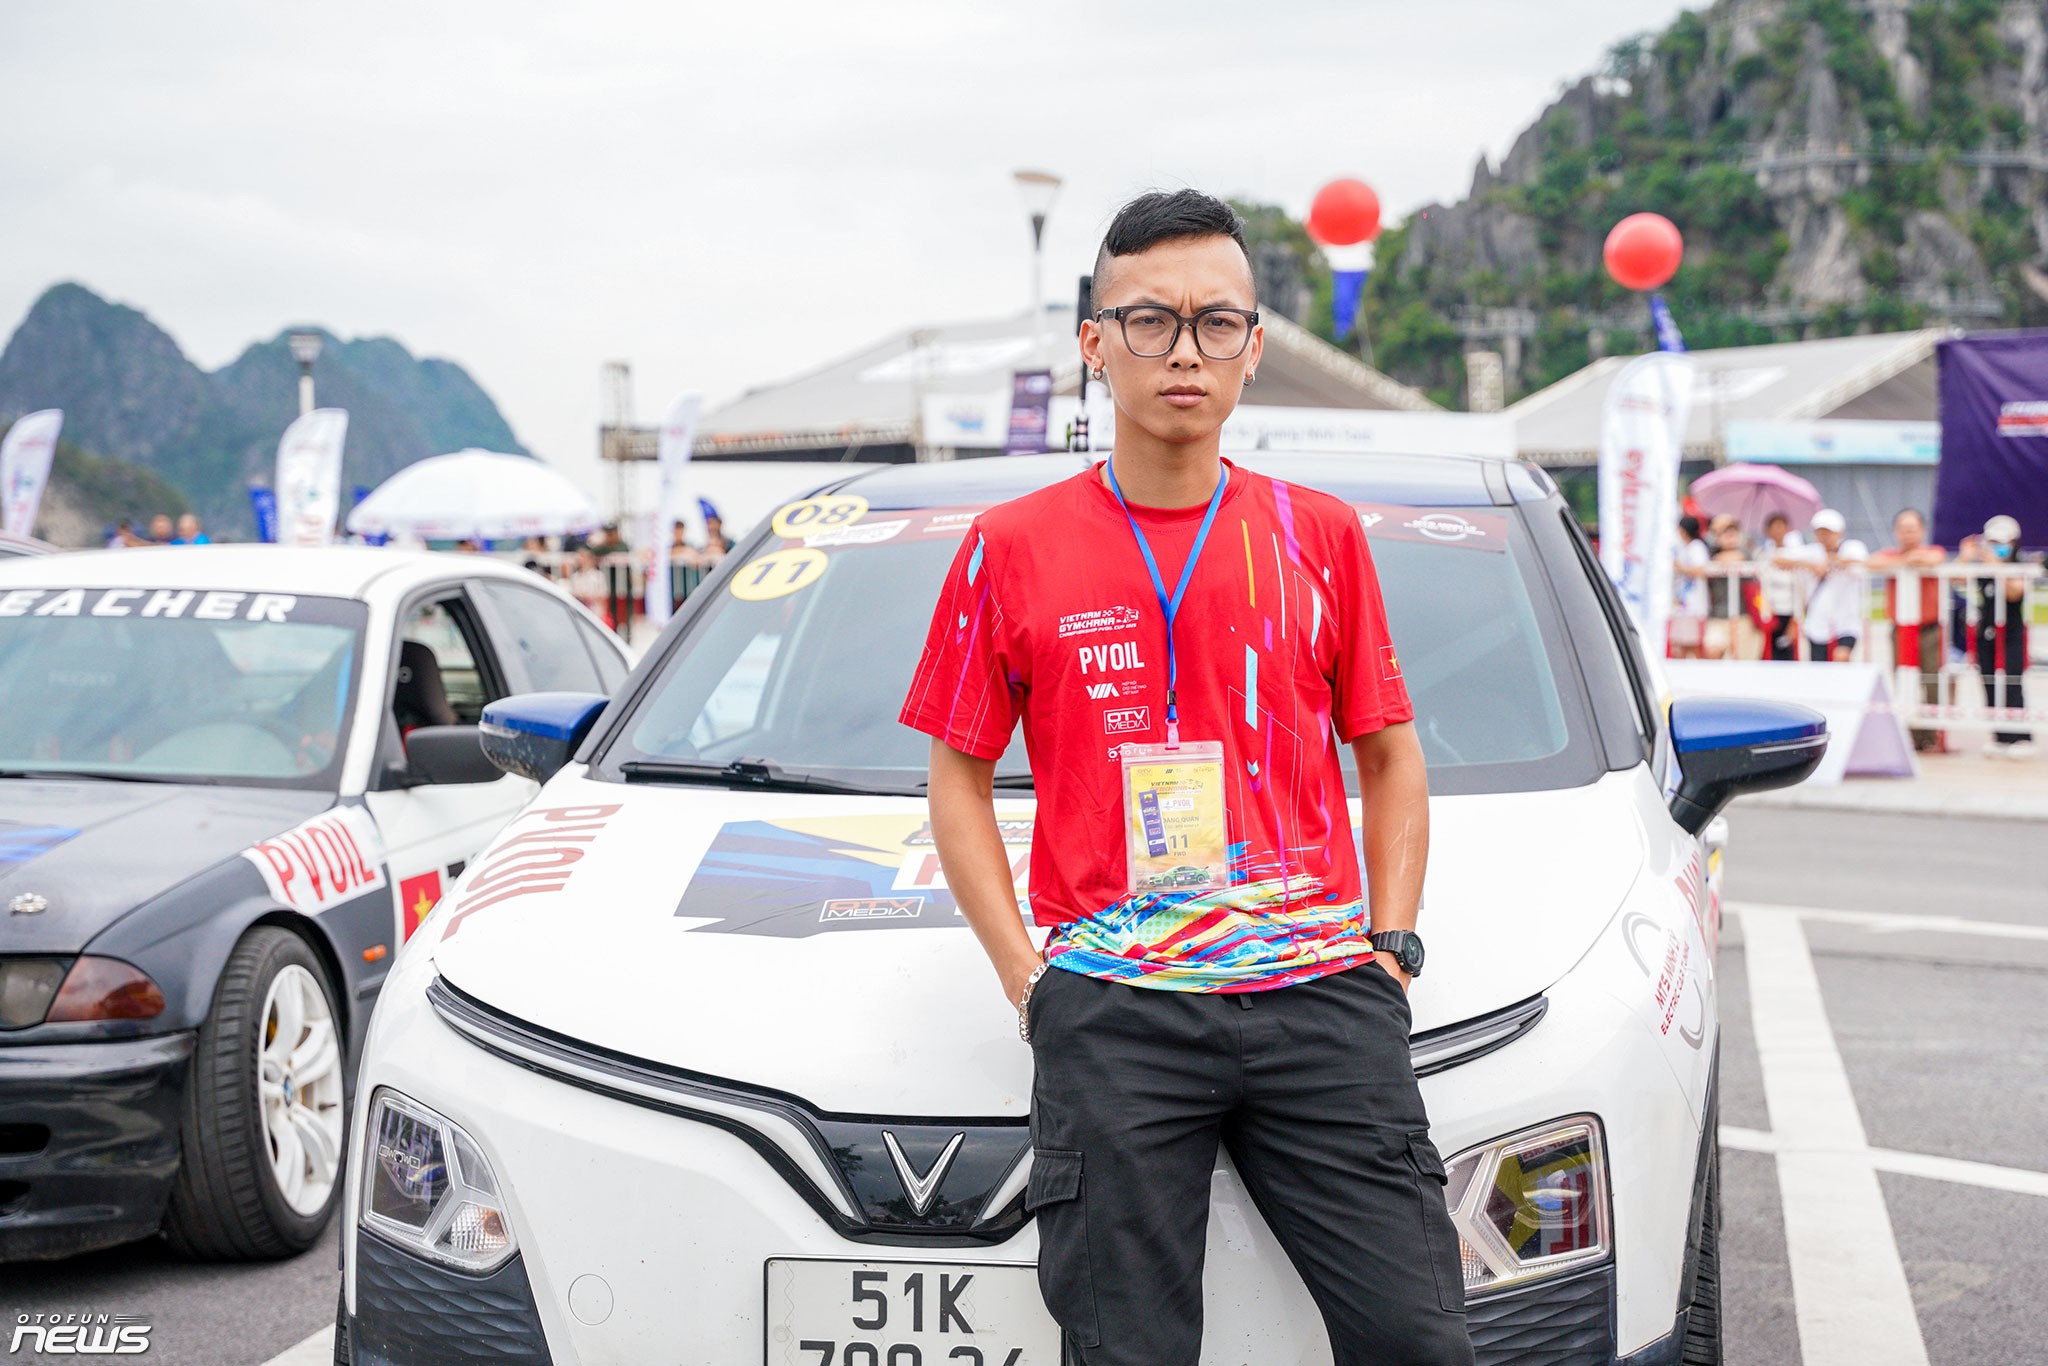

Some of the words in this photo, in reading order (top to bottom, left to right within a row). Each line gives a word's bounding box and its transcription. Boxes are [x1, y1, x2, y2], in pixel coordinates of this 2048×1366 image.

[786, 504, 857, 526] 08
[751, 559, 815, 586] 11
[1058, 617, 1116, 633] GYMKHANA
[1059, 610, 1102, 624] VIETNAM
[1078, 641, 1145, 675] PVOIL
[1107, 709, 1146, 723] OTV
[1108, 719, 1148, 731] MEDIA
[1169, 833, 1188, 849] 11
[255, 818, 375, 907] PVOIL
[440, 804, 624, 943] PVOIL
[827, 906, 913, 918] MEDIA
[852, 1270, 975, 1334] 51K
